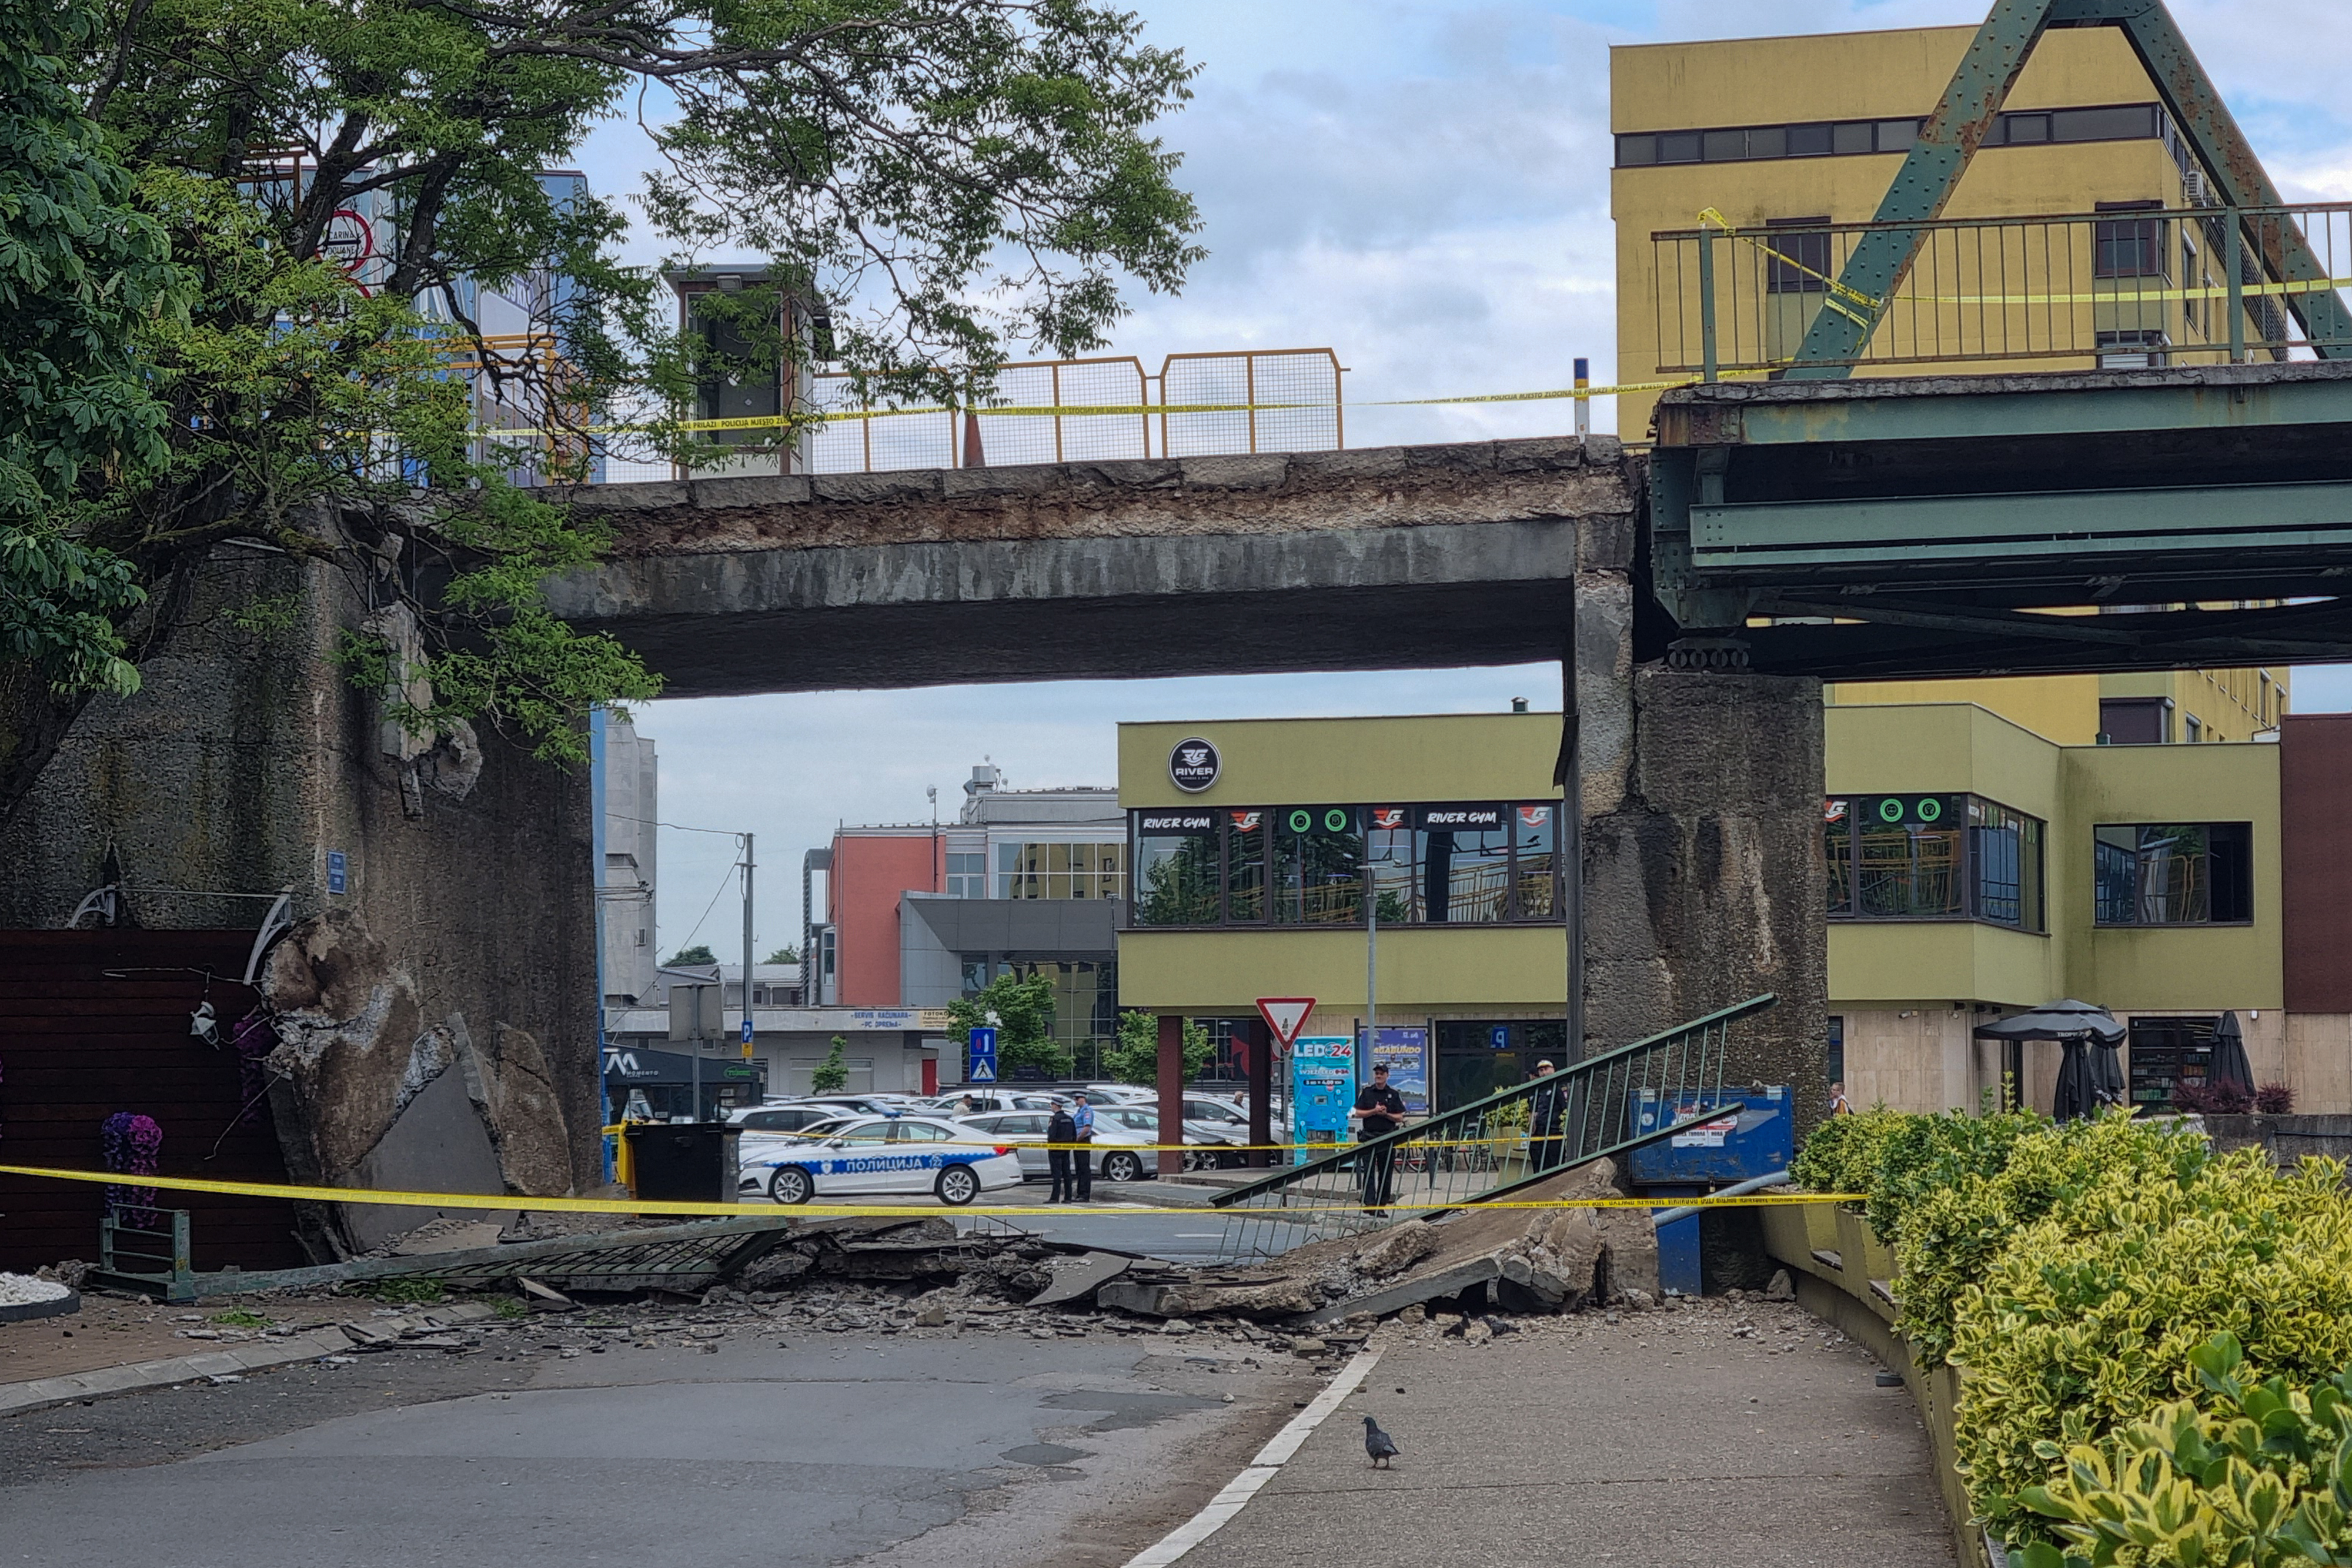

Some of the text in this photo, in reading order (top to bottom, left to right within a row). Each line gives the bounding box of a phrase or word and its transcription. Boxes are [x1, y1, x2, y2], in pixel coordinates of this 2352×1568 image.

[329, 230, 355, 239] CARINA
[328, 246, 355, 255] DOUANE
[1584, 387, 1608, 395] PRILAZI
[721, 419, 749, 427] POLICIJA
[750, 417, 774, 426] MJESTO
[1175, 767, 1214, 776] RIVER
[1428, 811, 1496, 823] RIVER GYM
[1143, 817, 1210, 830] RIVER GYM
[743, 1024, 750, 1041] P
[1294, 1044, 1352, 1058] LED 24
[846, 1158, 923, 1172] ПОЛИЦИЈА
[928, 1158, 943, 1168] 122
